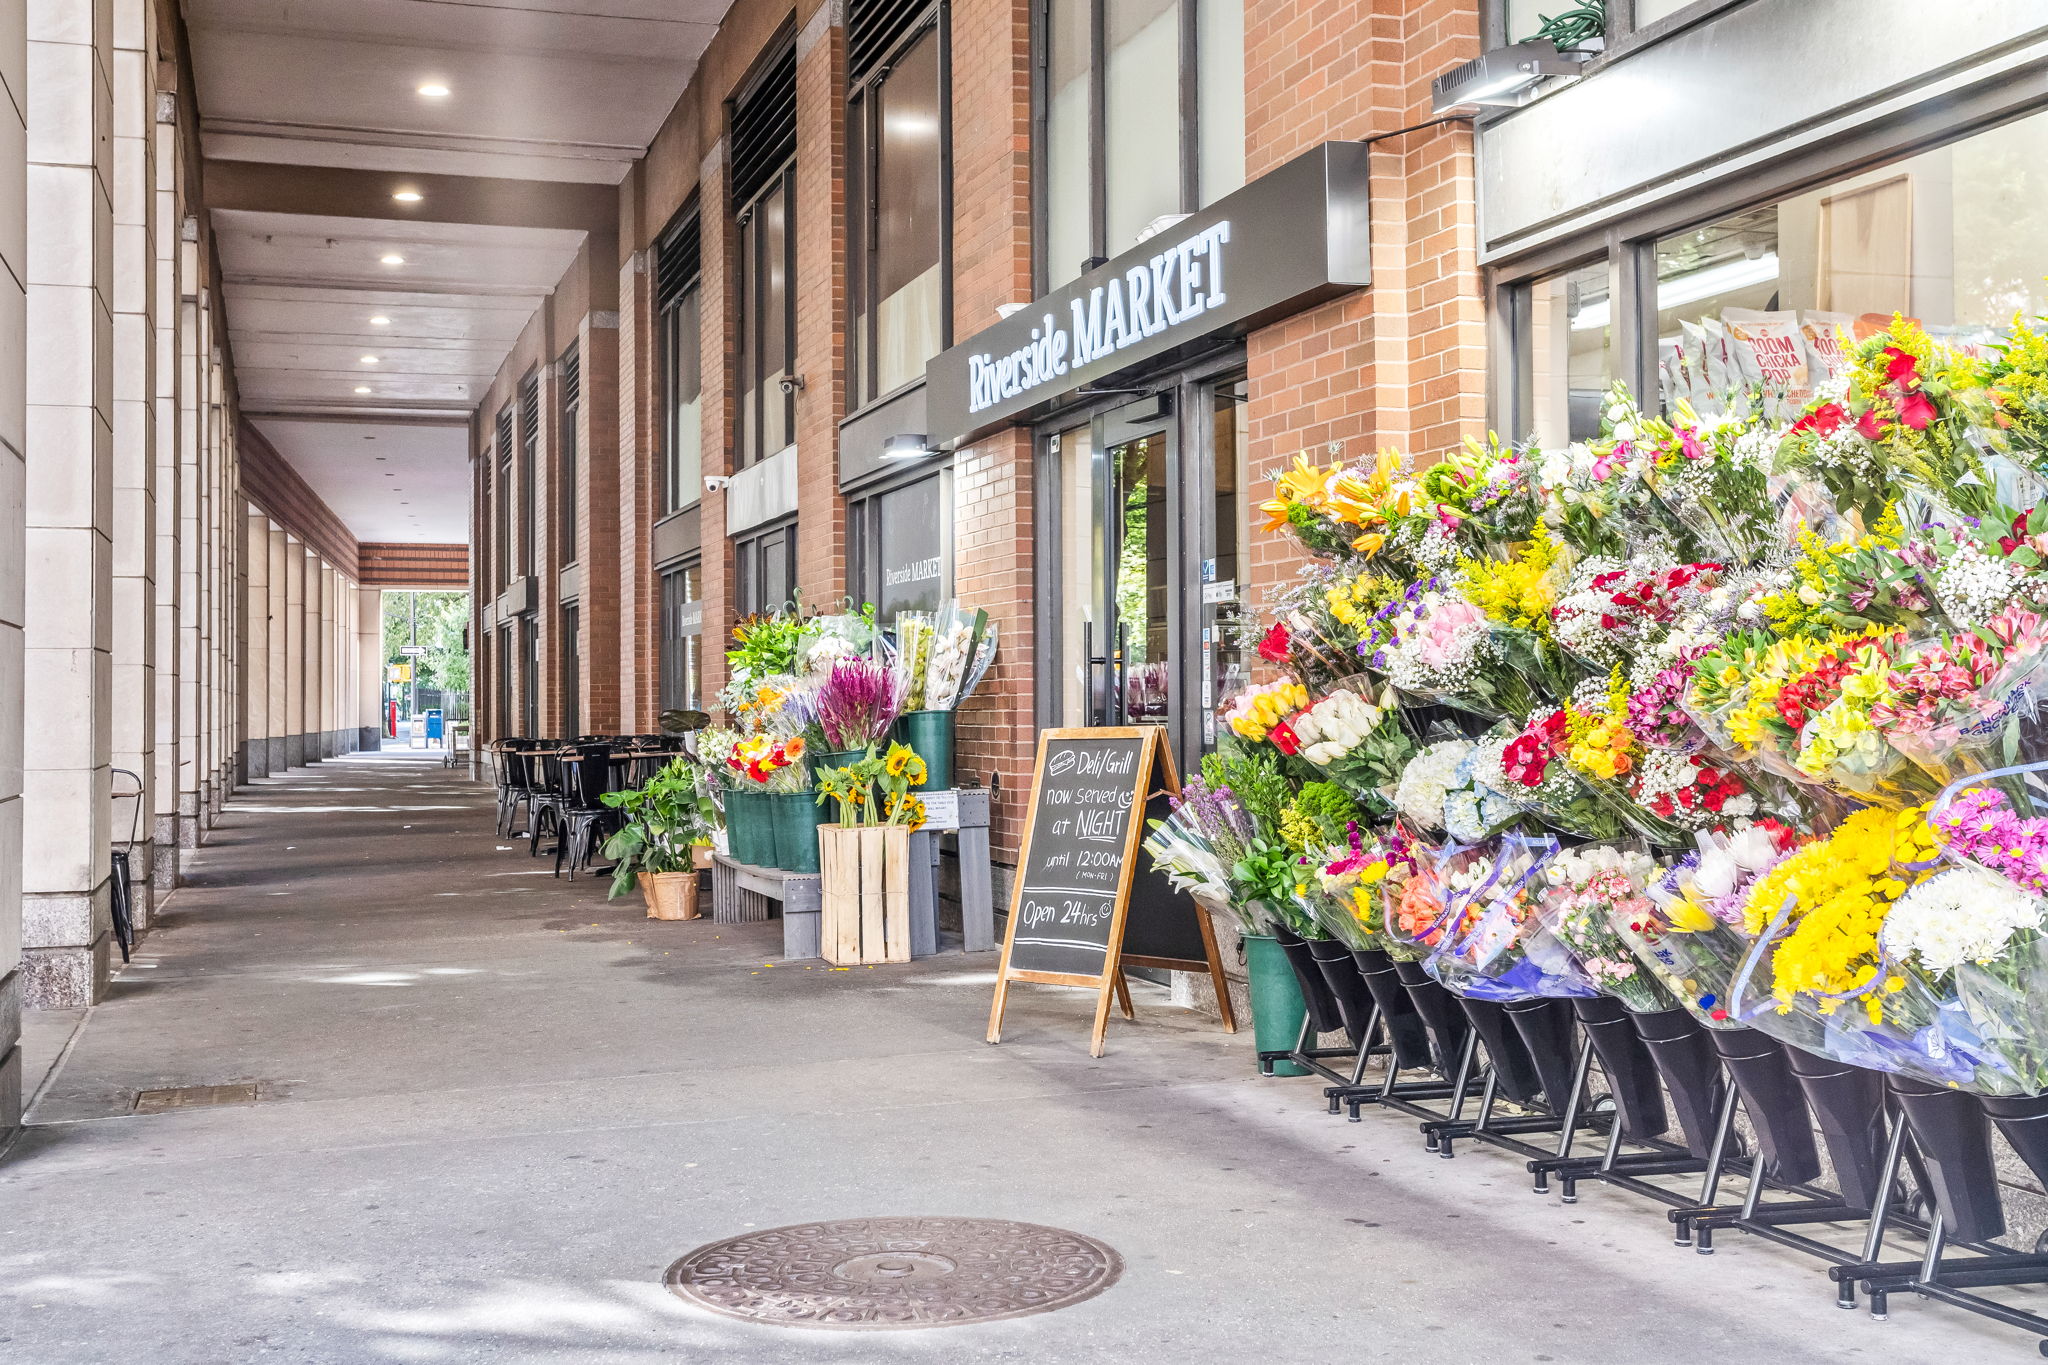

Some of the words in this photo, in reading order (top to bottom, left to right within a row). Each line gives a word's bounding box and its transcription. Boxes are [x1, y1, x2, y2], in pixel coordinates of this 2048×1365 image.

[969, 313, 1068, 413] Riverside
[1070, 220, 1231, 369] MARKET
[1747, 336, 1795, 354] BOOM
[1756, 354, 1801, 368] CHICKA
[886, 563, 911, 586] Riverside
[911, 557, 941, 581] MARKET
[1077, 749, 1134, 778] Deli/Grill
[1047, 789, 1073, 805] now
[1075, 786, 1118, 805] served
[1052, 818, 1071, 835] at
[1076, 810, 1126, 836] NIGHT
[1045, 852, 1070, 871] until
[1077, 851, 1123, 868] 12:00AM
[1023, 901, 1055, 929] Open
[1060, 901, 1098, 926] 24hrs
